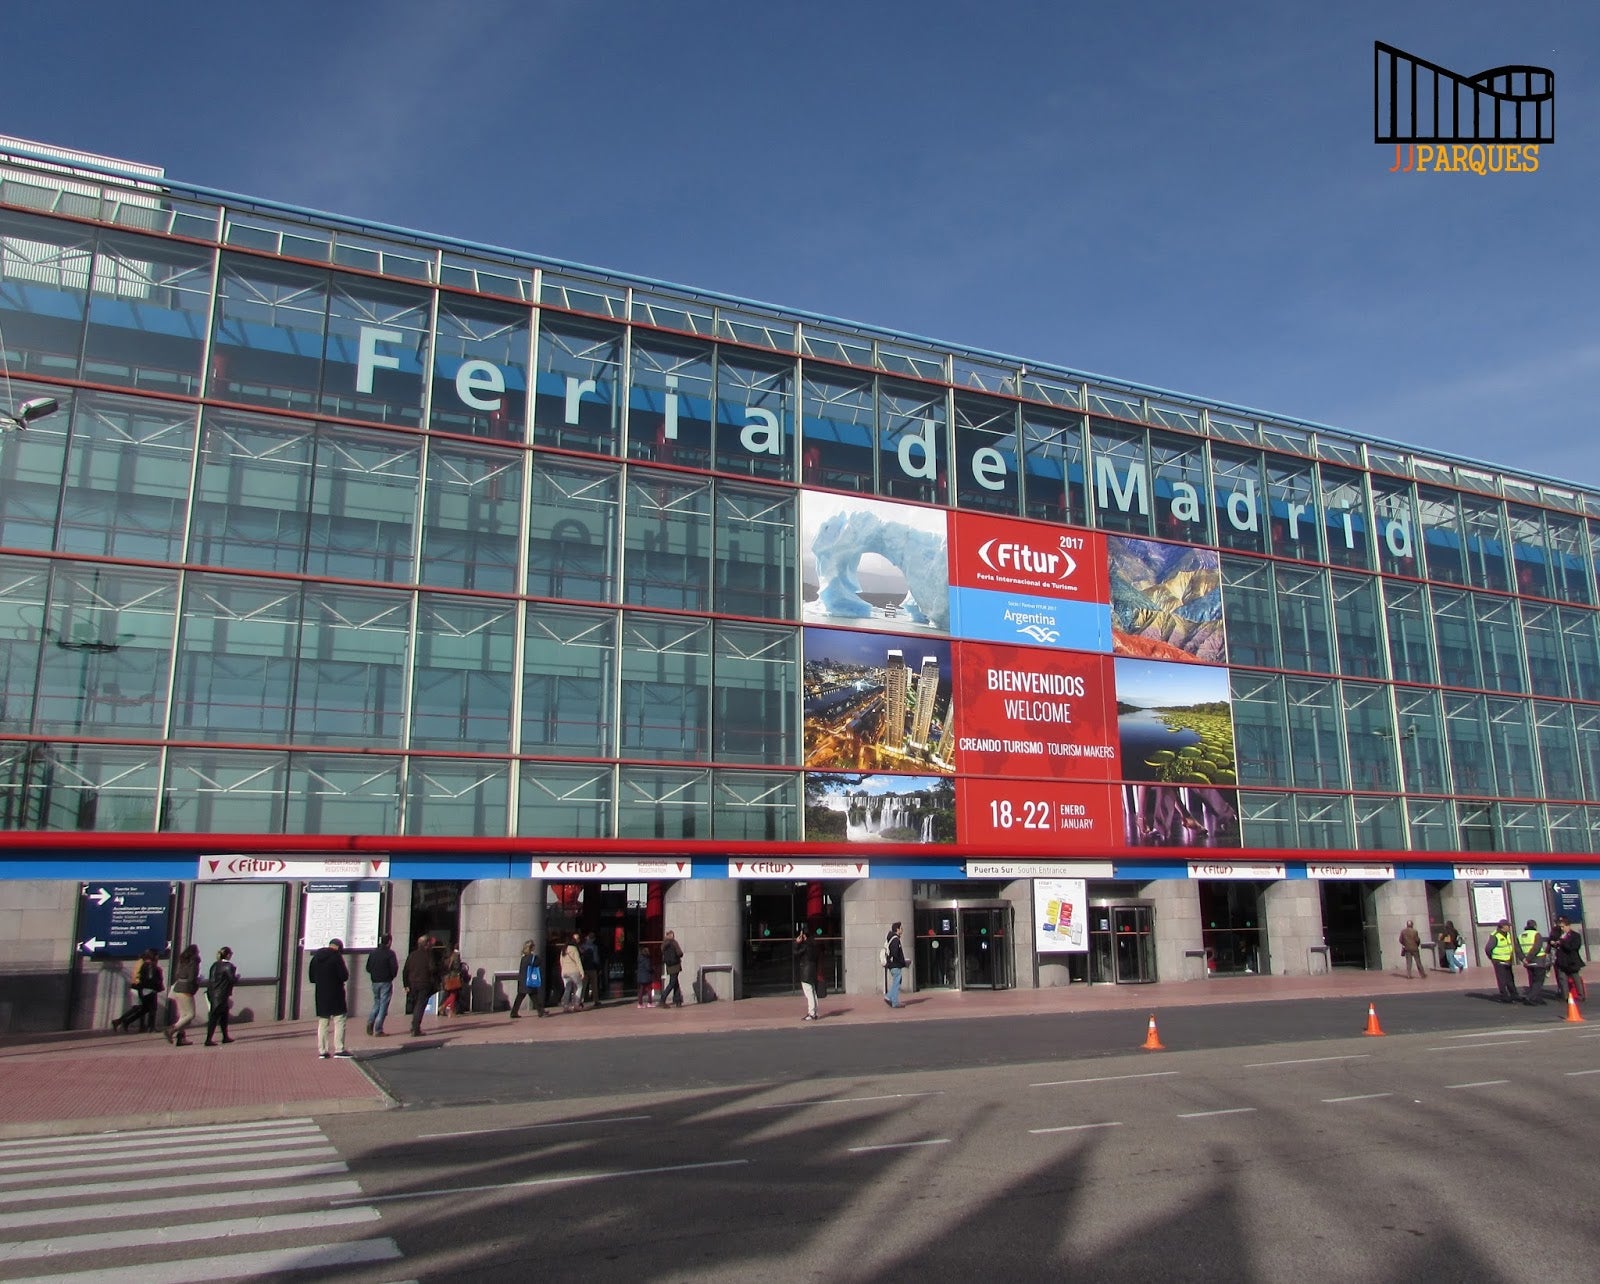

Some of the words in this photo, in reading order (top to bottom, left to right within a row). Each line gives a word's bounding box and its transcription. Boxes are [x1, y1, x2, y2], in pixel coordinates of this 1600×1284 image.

[356, 326, 780, 455] Feria
[898, 419, 1007, 491] de
[1096, 456, 1413, 558] Madrid
[1059, 536, 1084, 550] 2017
[997, 543, 1060, 574] Fitur
[976, 572, 994, 581] Feria
[996, 575, 1041, 587] Internacional
[1051, 582, 1078, 592] Turismo
[1004, 609, 1056, 626] Argentina
[987, 669, 1084, 697] BIENVENIDOS
[1004, 699, 1071, 723] WELCOME
[959, 737, 1001, 752] CREANDO
[1002, 740, 1043, 754] TURISMO
[1047, 742, 1082, 756] TOURISM
[1083, 745, 1115, 759] MAKERS
[1060, 804, 1085, 816] ENERO
[1060, 818, 1093, 829] JANUARY
[238, 859, 276, 873] Fitur
[566, 860, 598, 873] Fitur
[759, 861, 787, 874] Fitur
[974, 865, 999, 874] Puerta
[1001, 866, 1014, 874] Sur
[1017, 866, 1036, 875] South
[1038, 866, 1067, 875] Entrance
